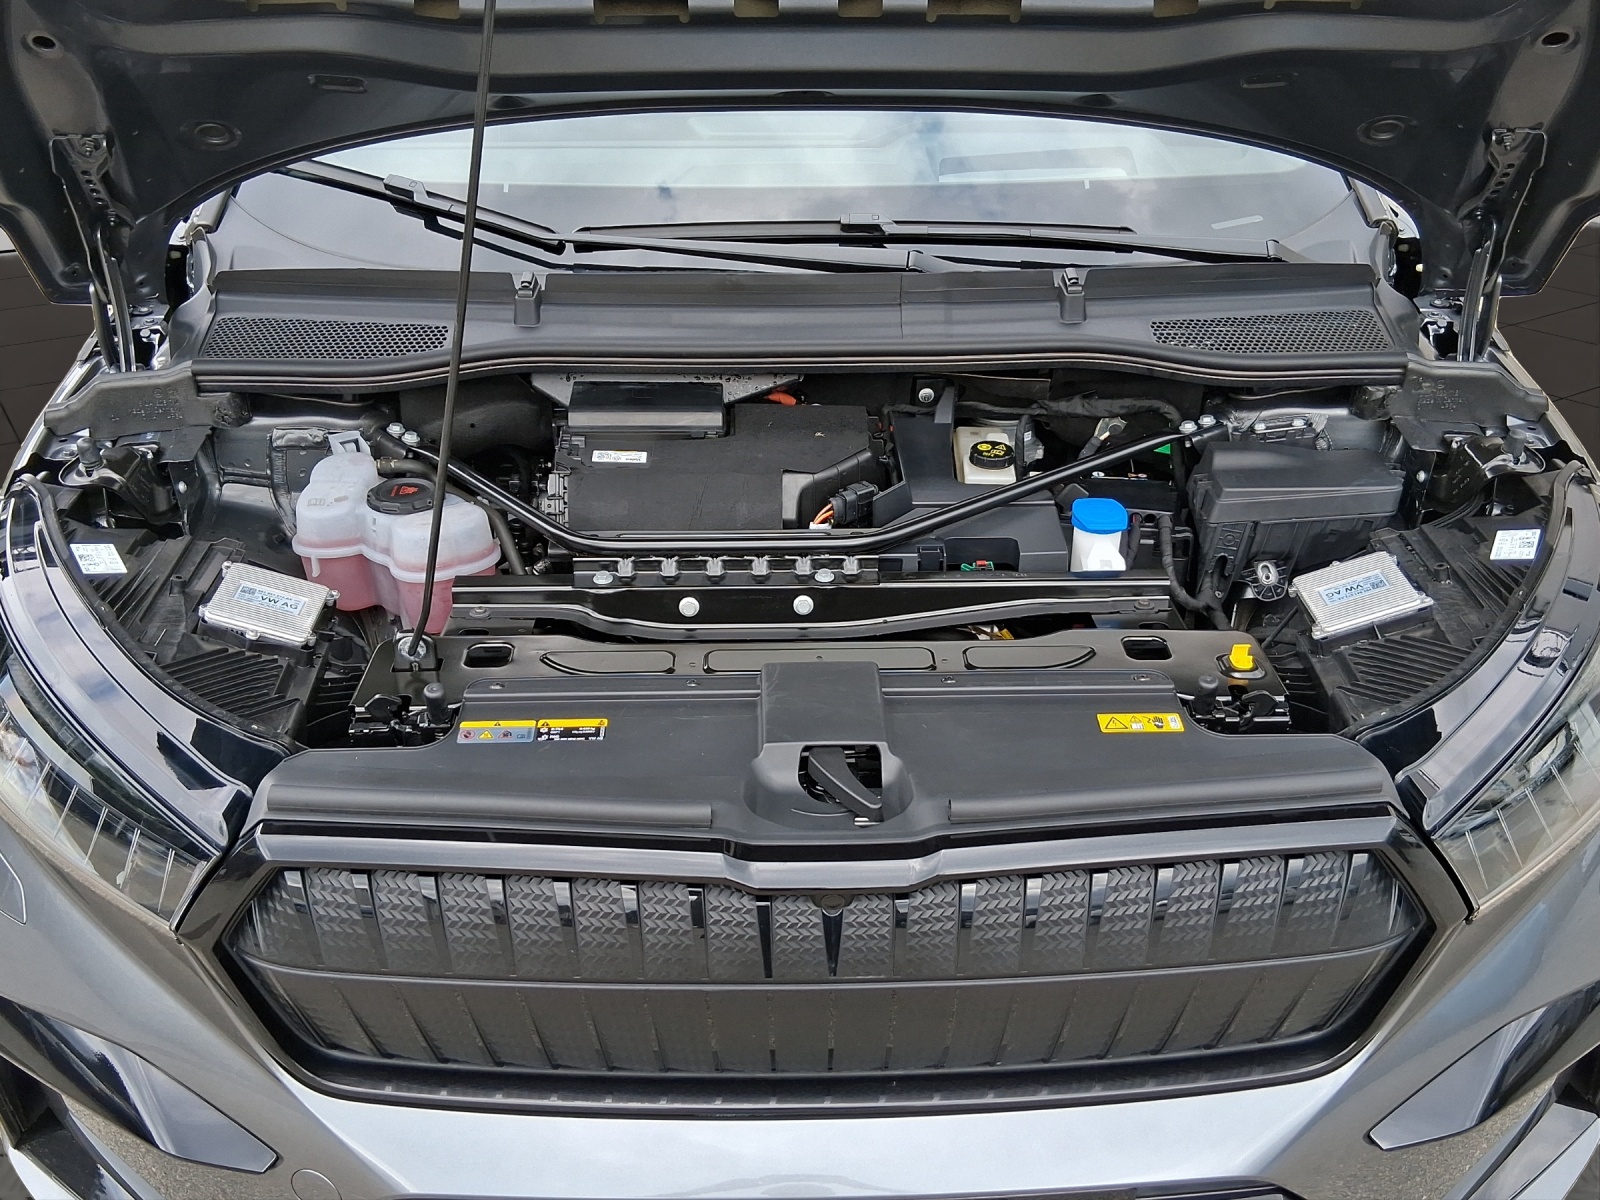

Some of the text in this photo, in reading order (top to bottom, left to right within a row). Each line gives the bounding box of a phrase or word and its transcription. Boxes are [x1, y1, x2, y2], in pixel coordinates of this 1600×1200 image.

[1345, 584, 1363, 592] VW
[1325, 589, 1341, 598] AG
[261, 595, 279, 604] VW
[281, 601, 298, 610] AG
